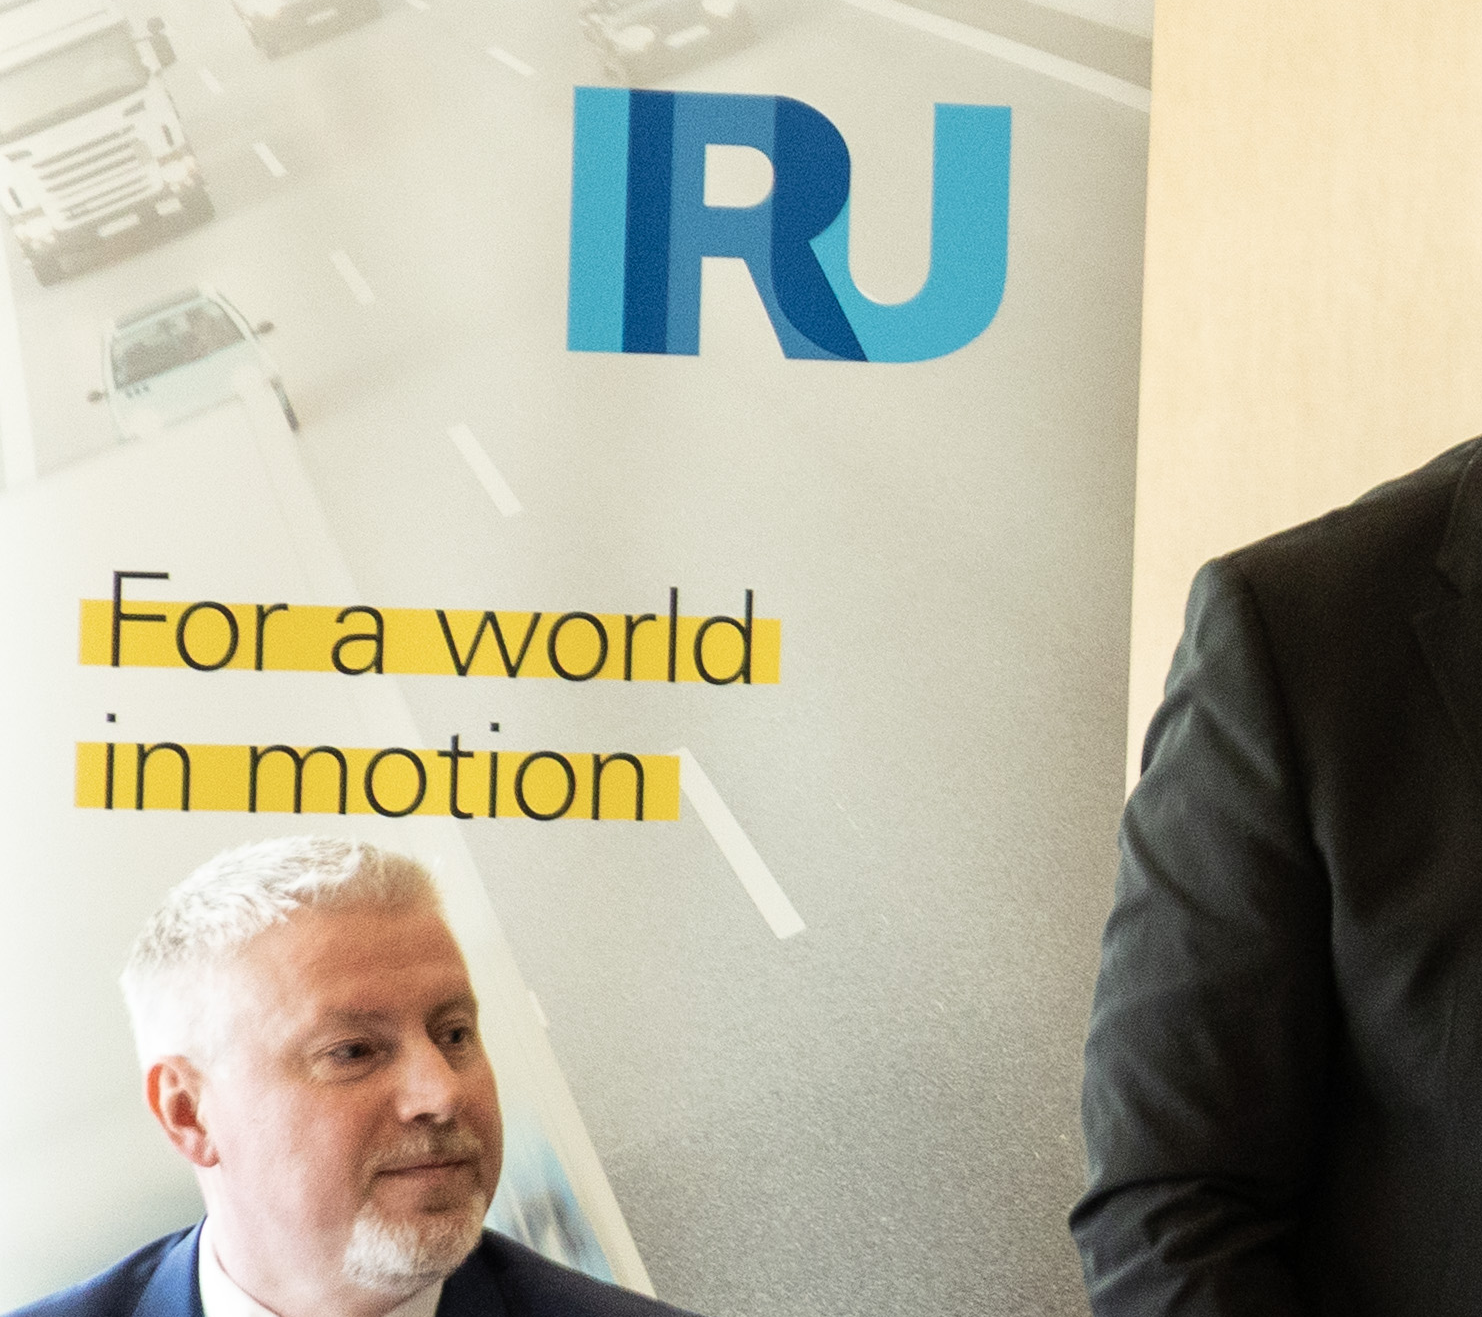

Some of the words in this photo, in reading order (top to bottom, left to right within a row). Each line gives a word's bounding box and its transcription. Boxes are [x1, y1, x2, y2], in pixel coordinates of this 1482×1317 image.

[566, 85, 1011, 363] IRU
[110, 570, 288, 673] For
[331, 604, 386, 674] a
[435, 586, 754, 686] world
[103, 713, 191, 811] in
[247, 722, 645, 821] motion
